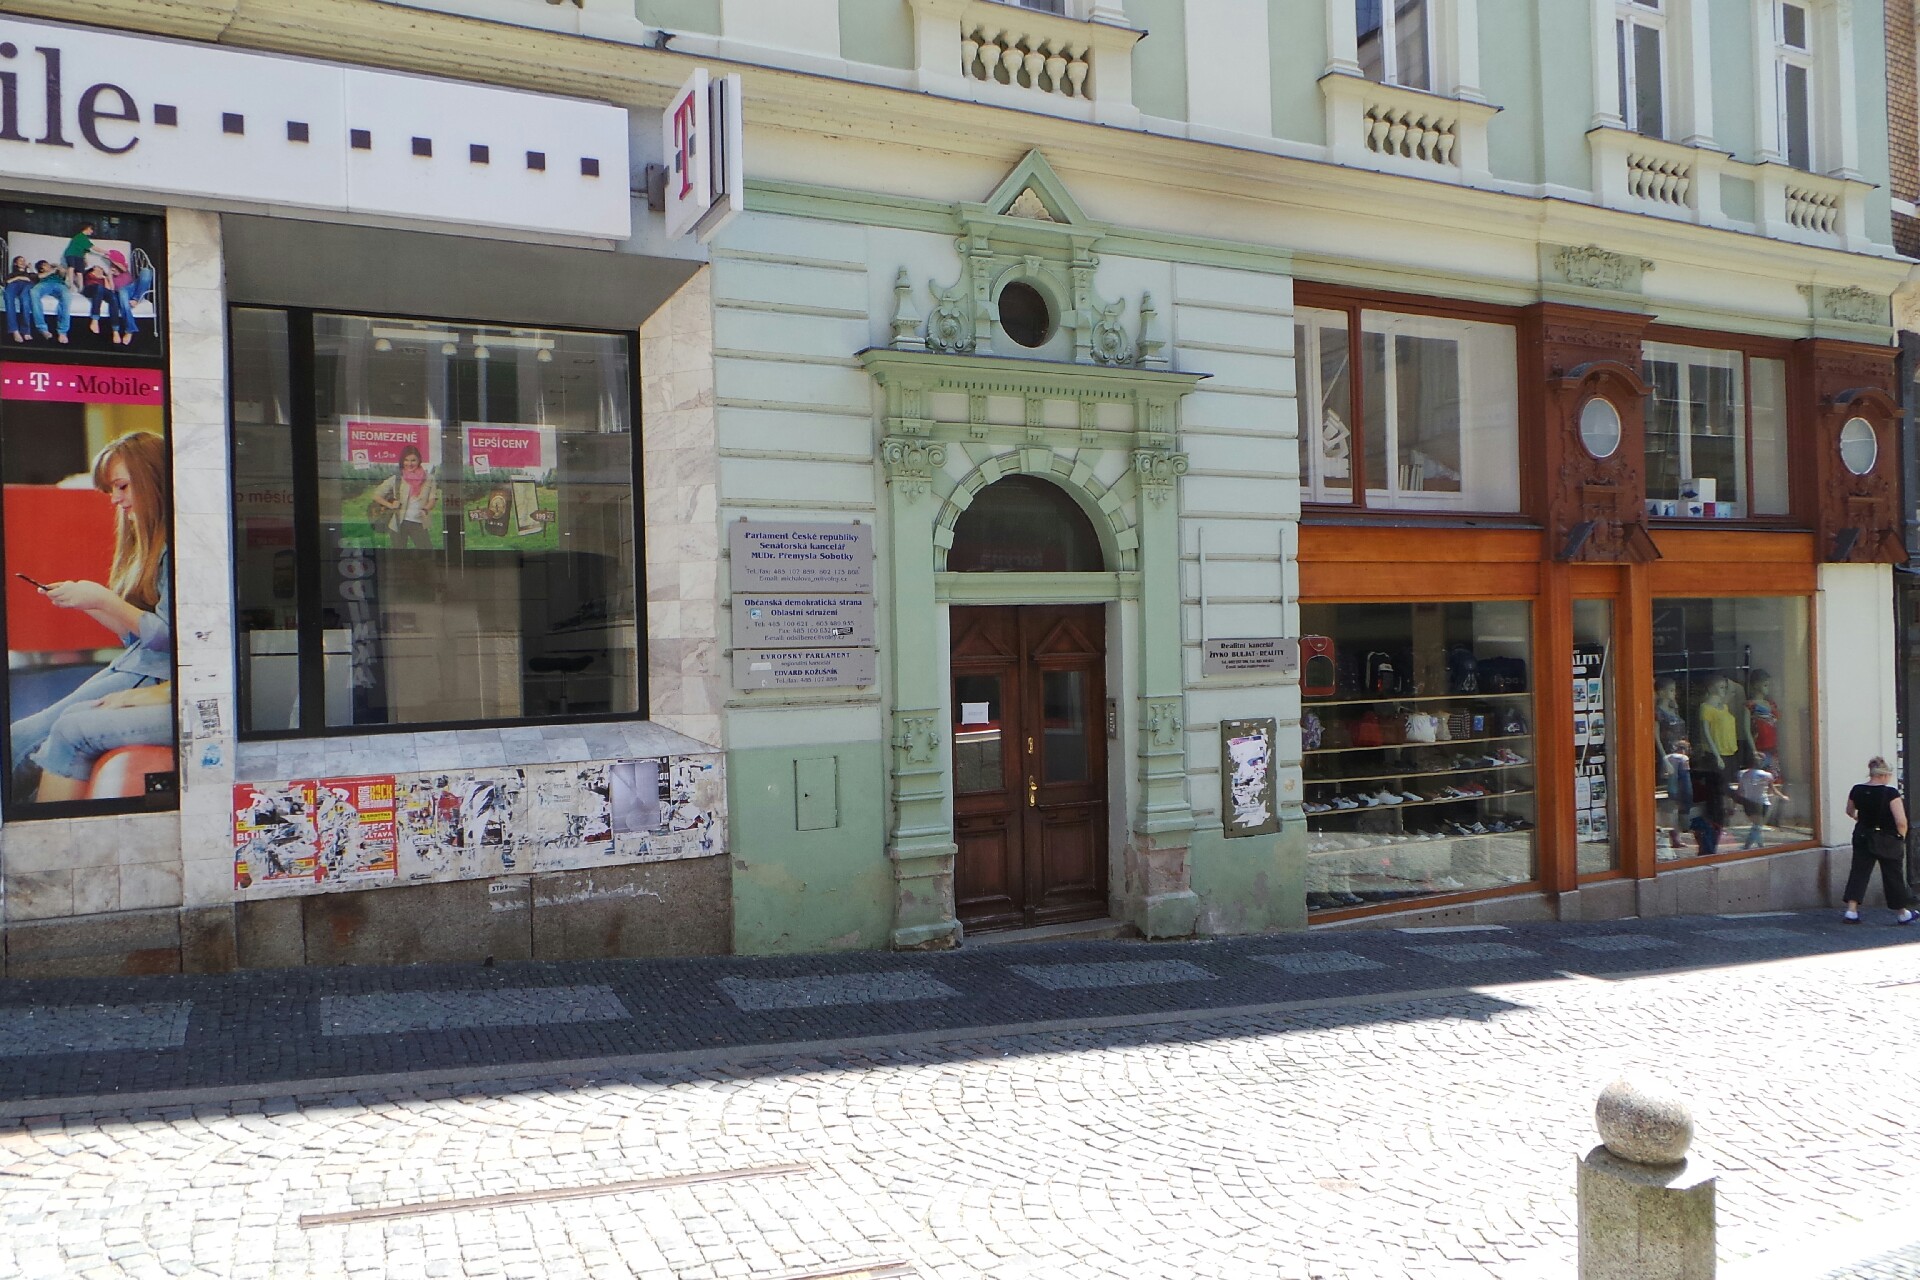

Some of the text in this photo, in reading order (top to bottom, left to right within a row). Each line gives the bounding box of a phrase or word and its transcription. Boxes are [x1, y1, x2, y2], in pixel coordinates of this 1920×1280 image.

[673, 89, 696, 201] T
[75, 374, 151, 397] Mobile
[351, 430, 418, 443] NEOMEZENÉ
[472, 436, 529, 449] LEPŠÍ CENY
[744, 532, 859, 543] Parlament České republiky
[759, 542, 846, 551] Senátorská kancelář
[778, 552, 817, 561] Přemysla
[819, 553, 854, 562] Sobotky
[744, 598, 782, 606] Občanská
[784, 598, 837, 606] demokratická
[806, 608, 838, 617] sdružení
[760, 652, 802, 660] EVROPSKÝ
[804, 668, 838, 676] KOŽUŠNÍK
